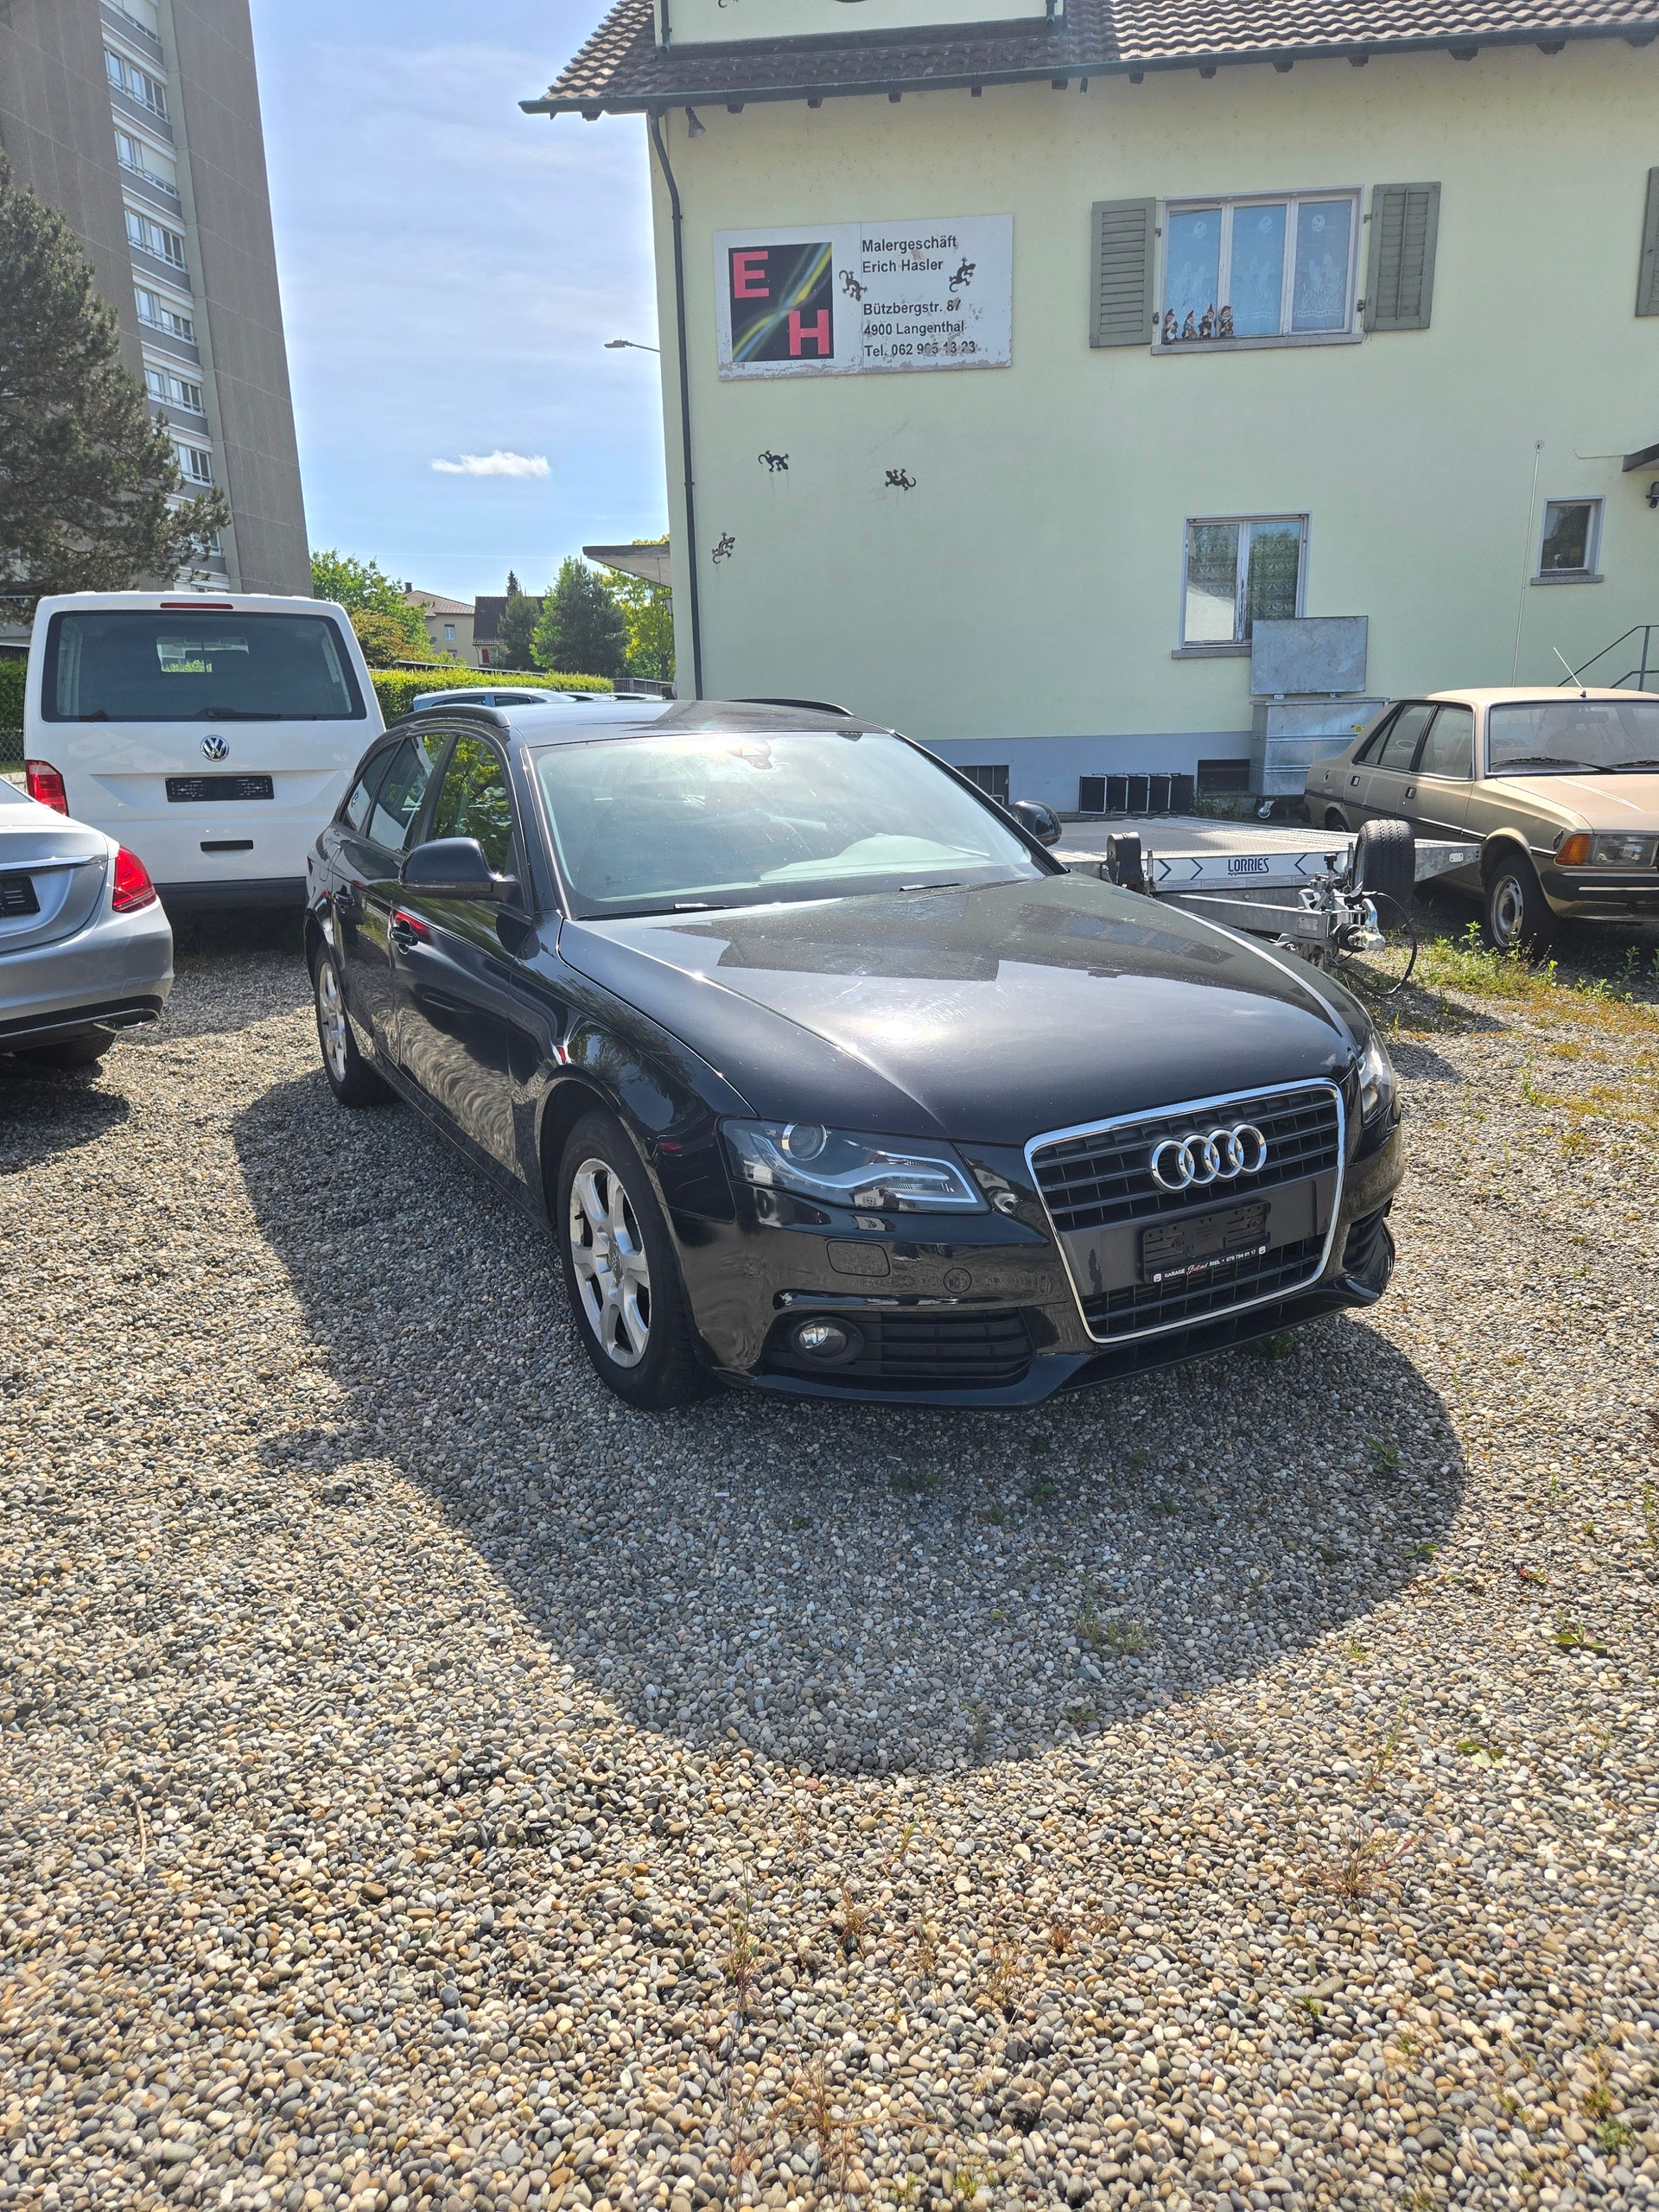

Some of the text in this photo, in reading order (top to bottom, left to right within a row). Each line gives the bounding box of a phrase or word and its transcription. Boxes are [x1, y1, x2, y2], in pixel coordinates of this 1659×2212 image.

[862, 235, 957, 254] Malergeschäft
[863, 258, 944, 273] Erich Hasler
[733, 251, 770, 299] E
[863, 299, 962, 316] Bützbergstr. 87
[789, 309, 830, 356] H
[864, 320, 964, 336] 4900 Langenthal
[864, 344, 887, 357] Tel.
[891, 343, 913, 356] 062
[1228, 857, 1269, 874] LORRIES
[1164, 1268, 1185, 1278] GARAGE
